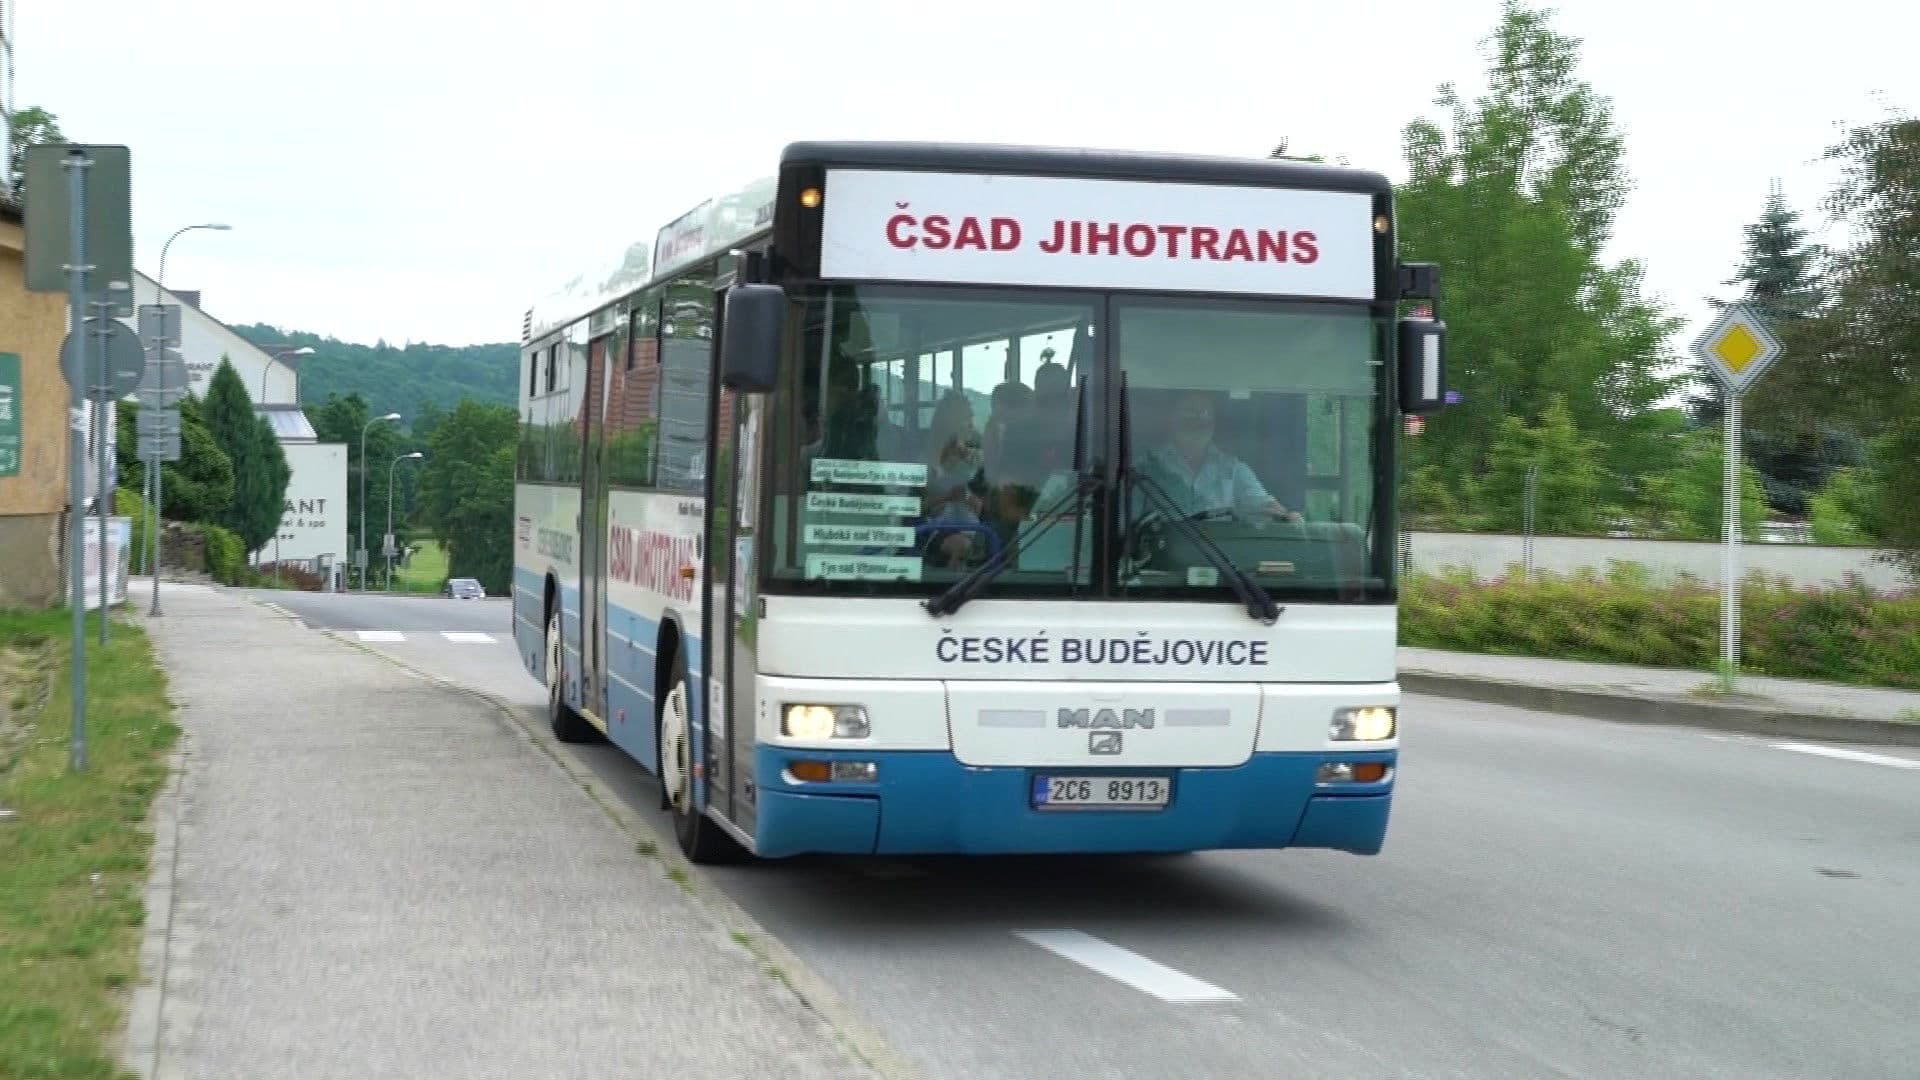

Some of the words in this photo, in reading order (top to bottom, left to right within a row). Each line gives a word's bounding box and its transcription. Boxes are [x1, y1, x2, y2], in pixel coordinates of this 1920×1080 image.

[886, 201, 1021, 251] ČSAD
[1038, 220, 1319, 264] JIHOTRANS
[936, 628, 1049, 665] ČESKÉ
[1061, 630, 1269, 666] BUDĚJOVICE
[1057, 708, 1155, 729] MAN
[1053, 780, 1091, 801] 2C6
[1107, 780, 1160, 801] 8913
